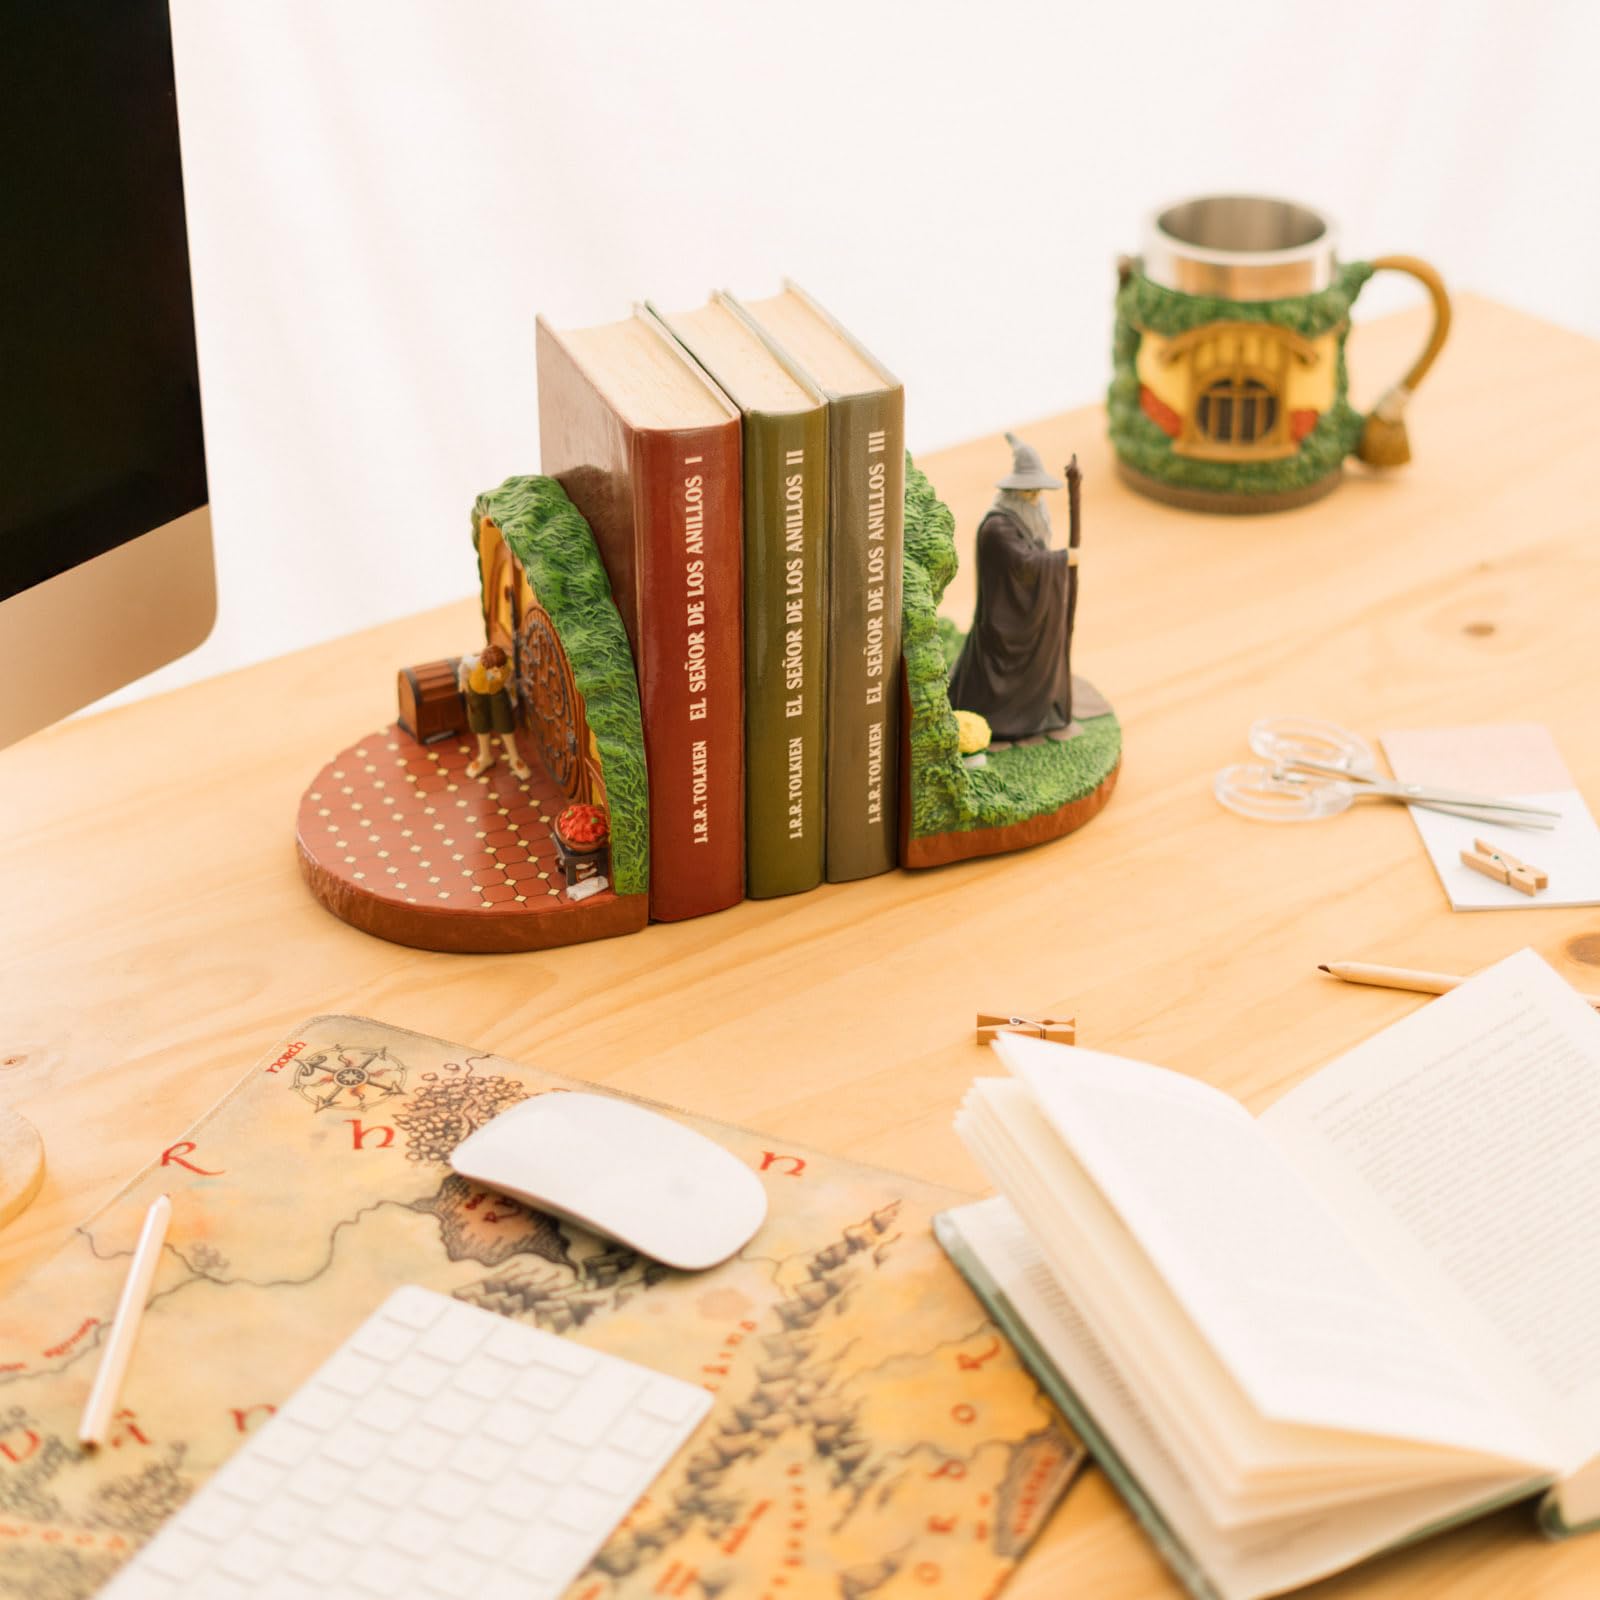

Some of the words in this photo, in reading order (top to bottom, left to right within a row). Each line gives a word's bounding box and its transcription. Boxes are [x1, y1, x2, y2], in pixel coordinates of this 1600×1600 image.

[786, 449, 804, 465] II
[868, 430, 885, 453] III
[685, 455, 703, 465] I
[685, 475, 704, 555] ANILLOS
[786, 473, 804, 553] ANILLOS
[868, 462, 885, 541] ANILLOS
[686, 559, 705, 598] LOS
[786, 557, 804, 596] LOS
[868, 545, 885, 584] LOS
[687, 600, 705, 627] DE
[786, 598, 803, 625] DE
[867, 585, 884, 612] DE
[684, 630, 707, 693] SEÑOR
[782, 628, 803, 690] SEÑOR
[863, 615, 884, 678] SEÑOR
[689, 697, 707, 721] EL
[786, 694, 803, 718] EL
[866, 681, 882, 705] EL
